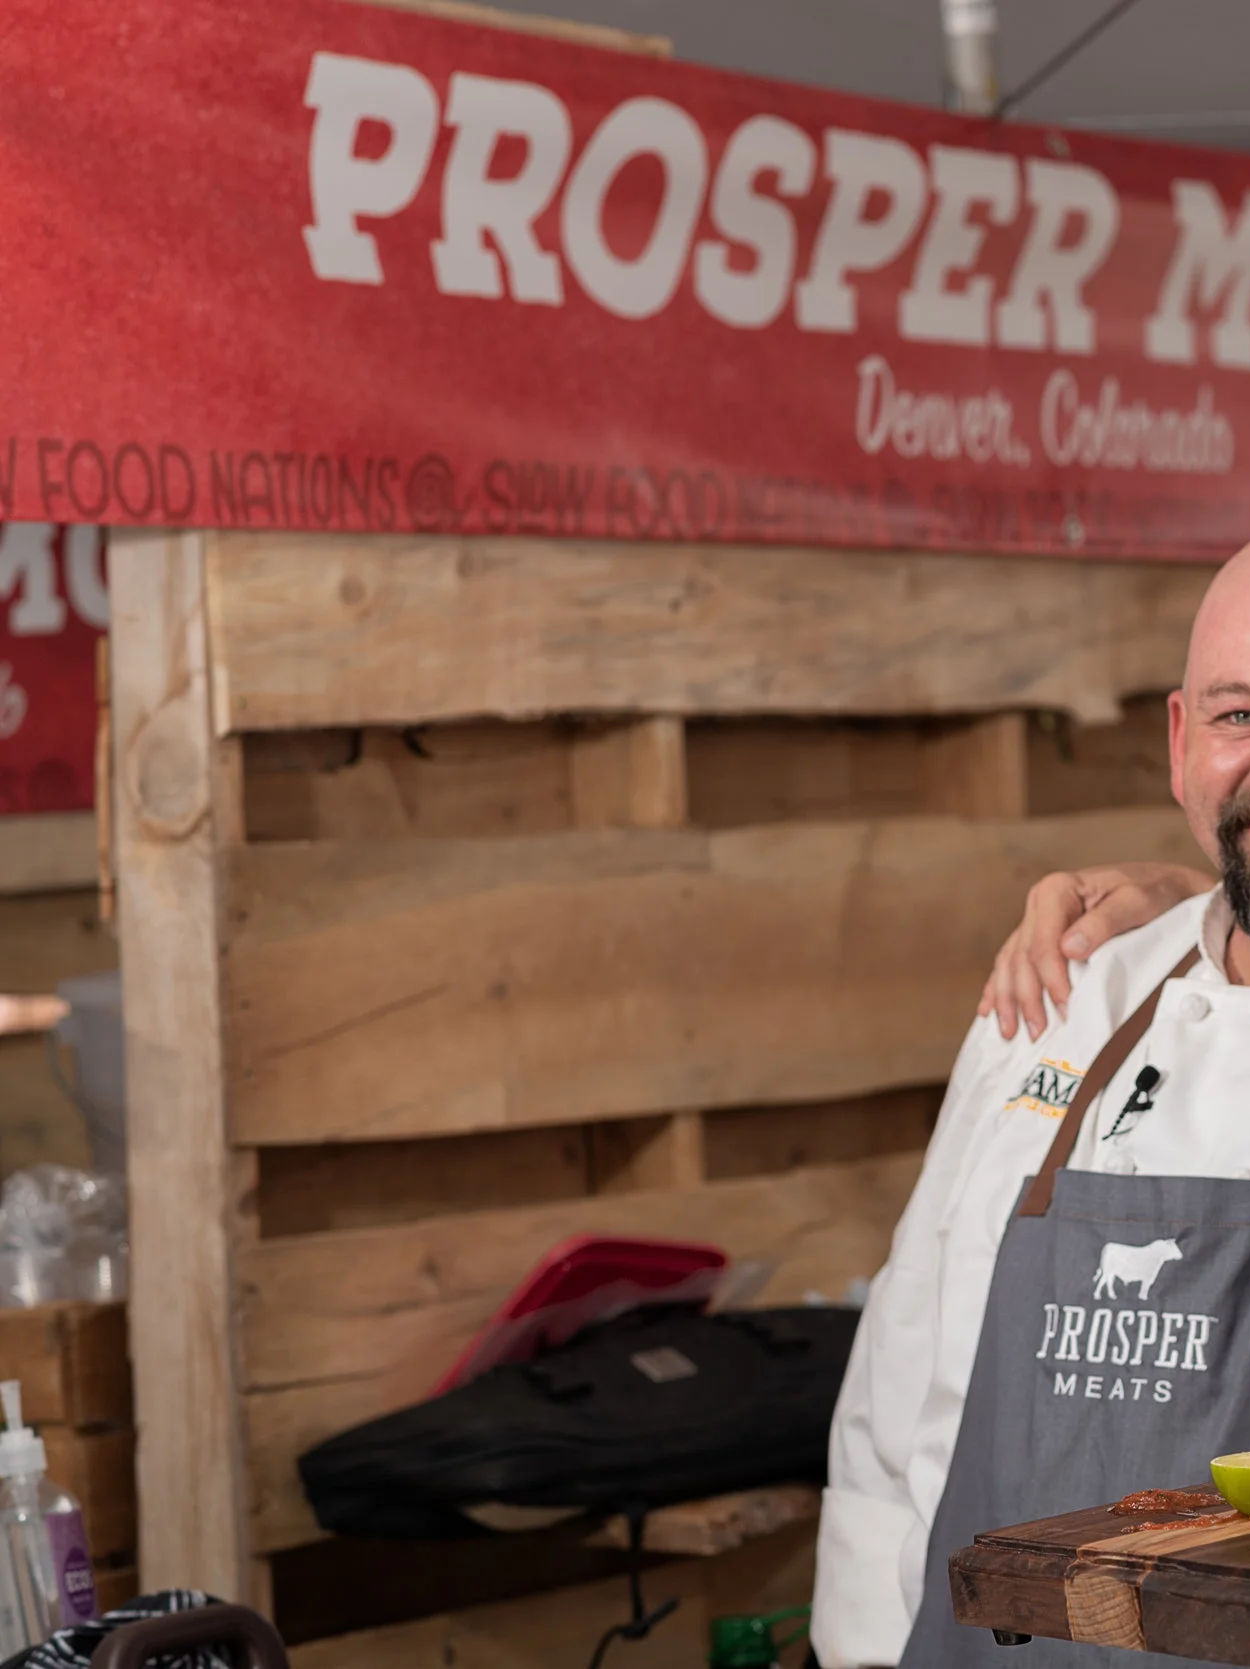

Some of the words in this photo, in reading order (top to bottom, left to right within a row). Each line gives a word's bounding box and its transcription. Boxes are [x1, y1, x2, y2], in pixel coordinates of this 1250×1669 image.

[302, 50, 1120, 356] PROSPER
[855, 353, 1032, 468] Denver,
[1040, 367, 1235, 475] Colorado
[37, 436, 197, 520] FOOD
[1036, 1303, 1208, 1371] PROSPER
[1053, 1372, 1173, 1403] MEATS
